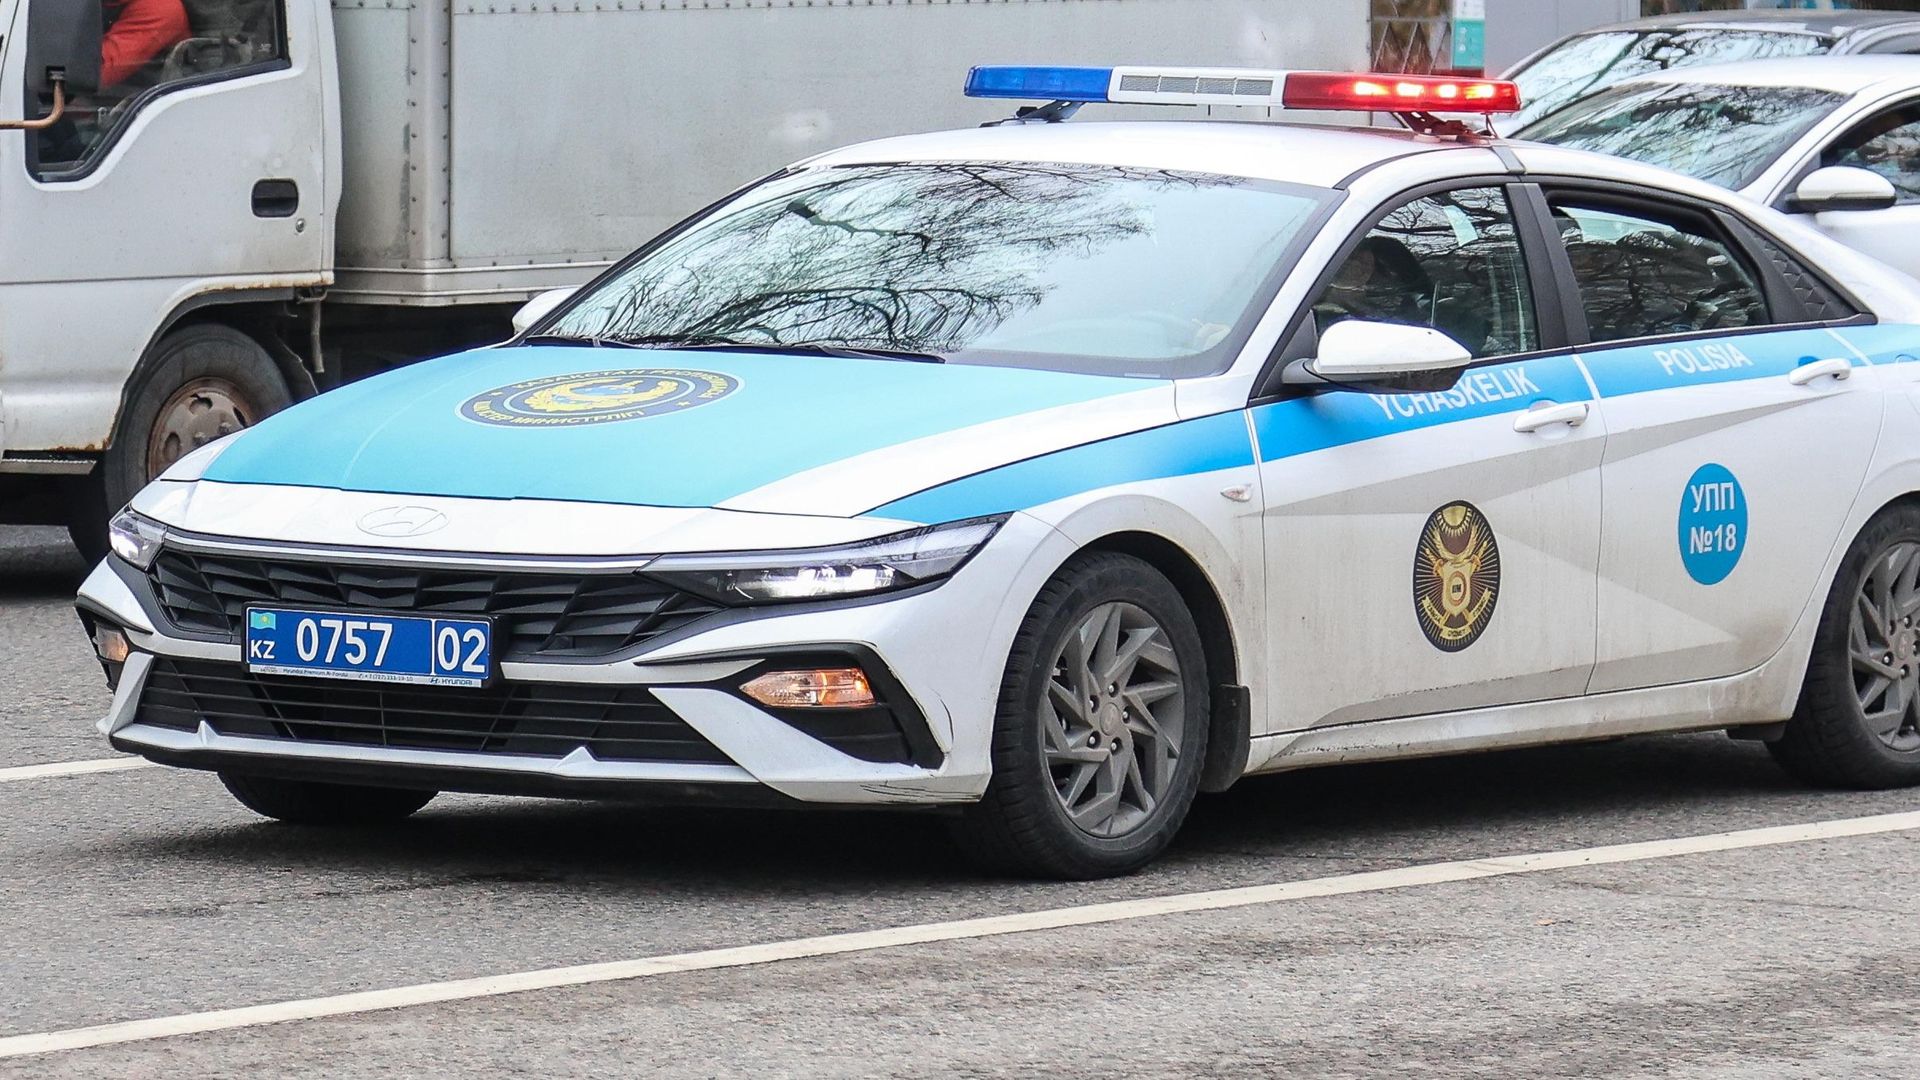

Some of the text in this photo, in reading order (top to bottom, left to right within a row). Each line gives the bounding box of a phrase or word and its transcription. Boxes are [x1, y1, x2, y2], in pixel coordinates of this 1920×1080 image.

[1653, 342, 1754, 376] POLISIA
[1368, 366, 1541, 420] YCHASKELIK
[1690, 482, 1735, 513] УПП
[1689, 523, 1737, 554] №18
[250, 639, 276, 660] KZ
[296, 617, 393, 667] 0757
[437, 627, 486, 673] 02
